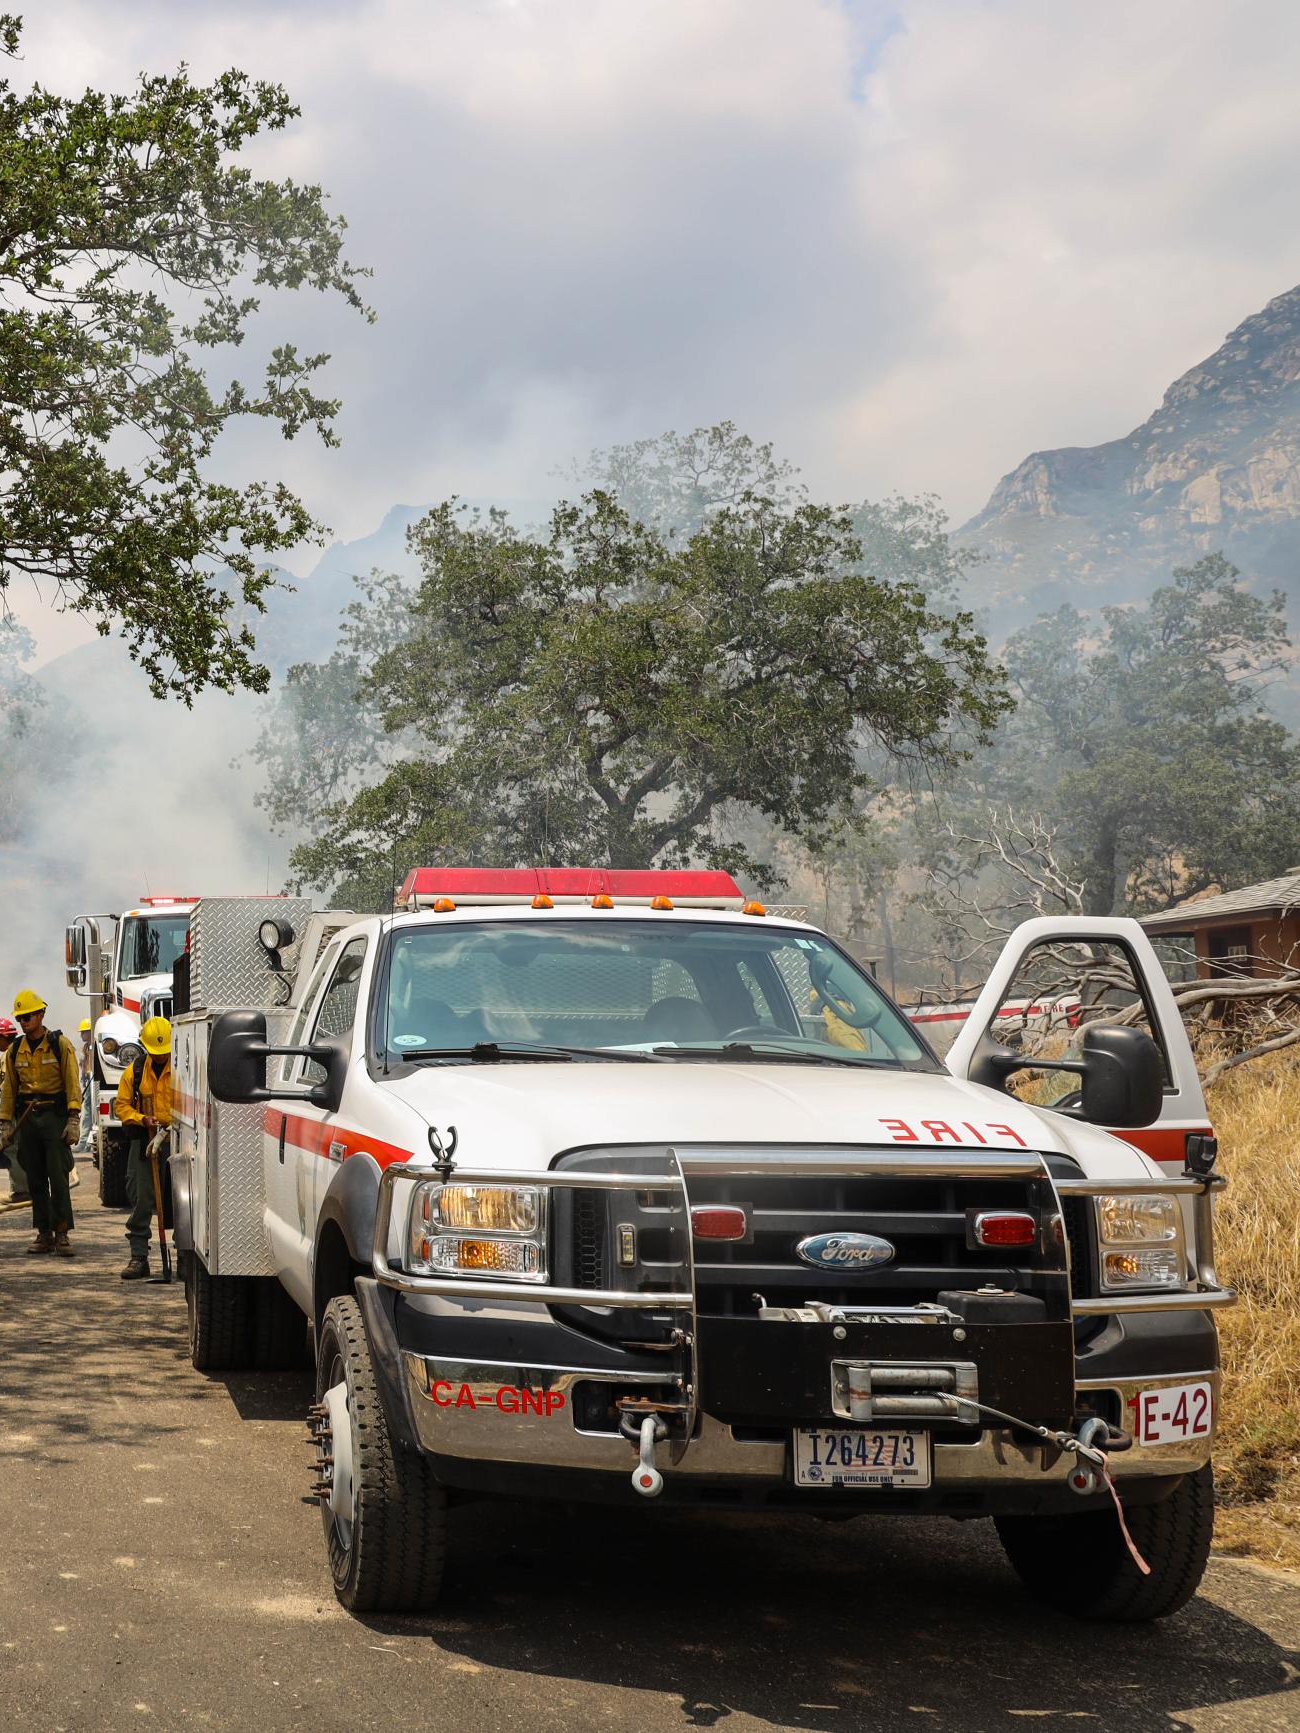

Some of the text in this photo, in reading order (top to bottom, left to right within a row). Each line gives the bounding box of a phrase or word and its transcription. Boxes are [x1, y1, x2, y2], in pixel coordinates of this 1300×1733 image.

[821, 1238, 876, 1261] Ford
[431, 1380, 566, 1416] CA-GNP
[832, 1475, 893, 1483] FOR OFFICIAL USE ONLY
